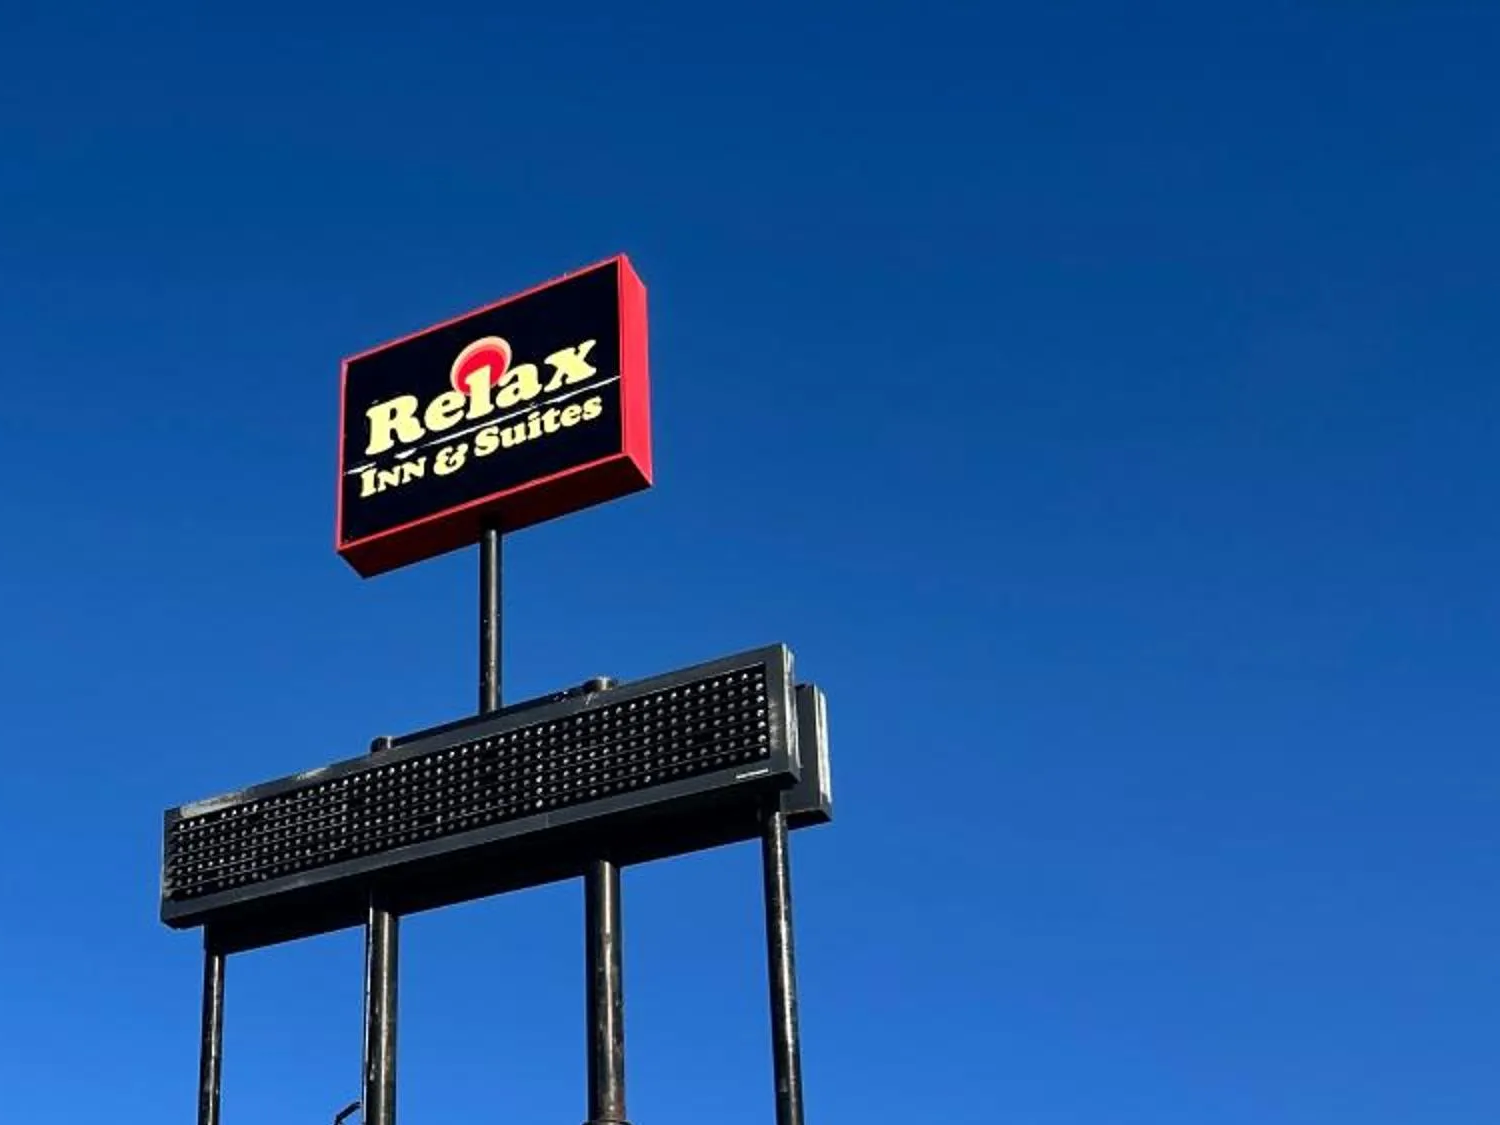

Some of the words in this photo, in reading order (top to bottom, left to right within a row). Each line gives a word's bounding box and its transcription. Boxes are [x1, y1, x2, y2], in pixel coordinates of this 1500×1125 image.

[365, 338, 597, 455] Relax
[433, 443, 469, 476] &
[474, 396, 603, 457] Suites
